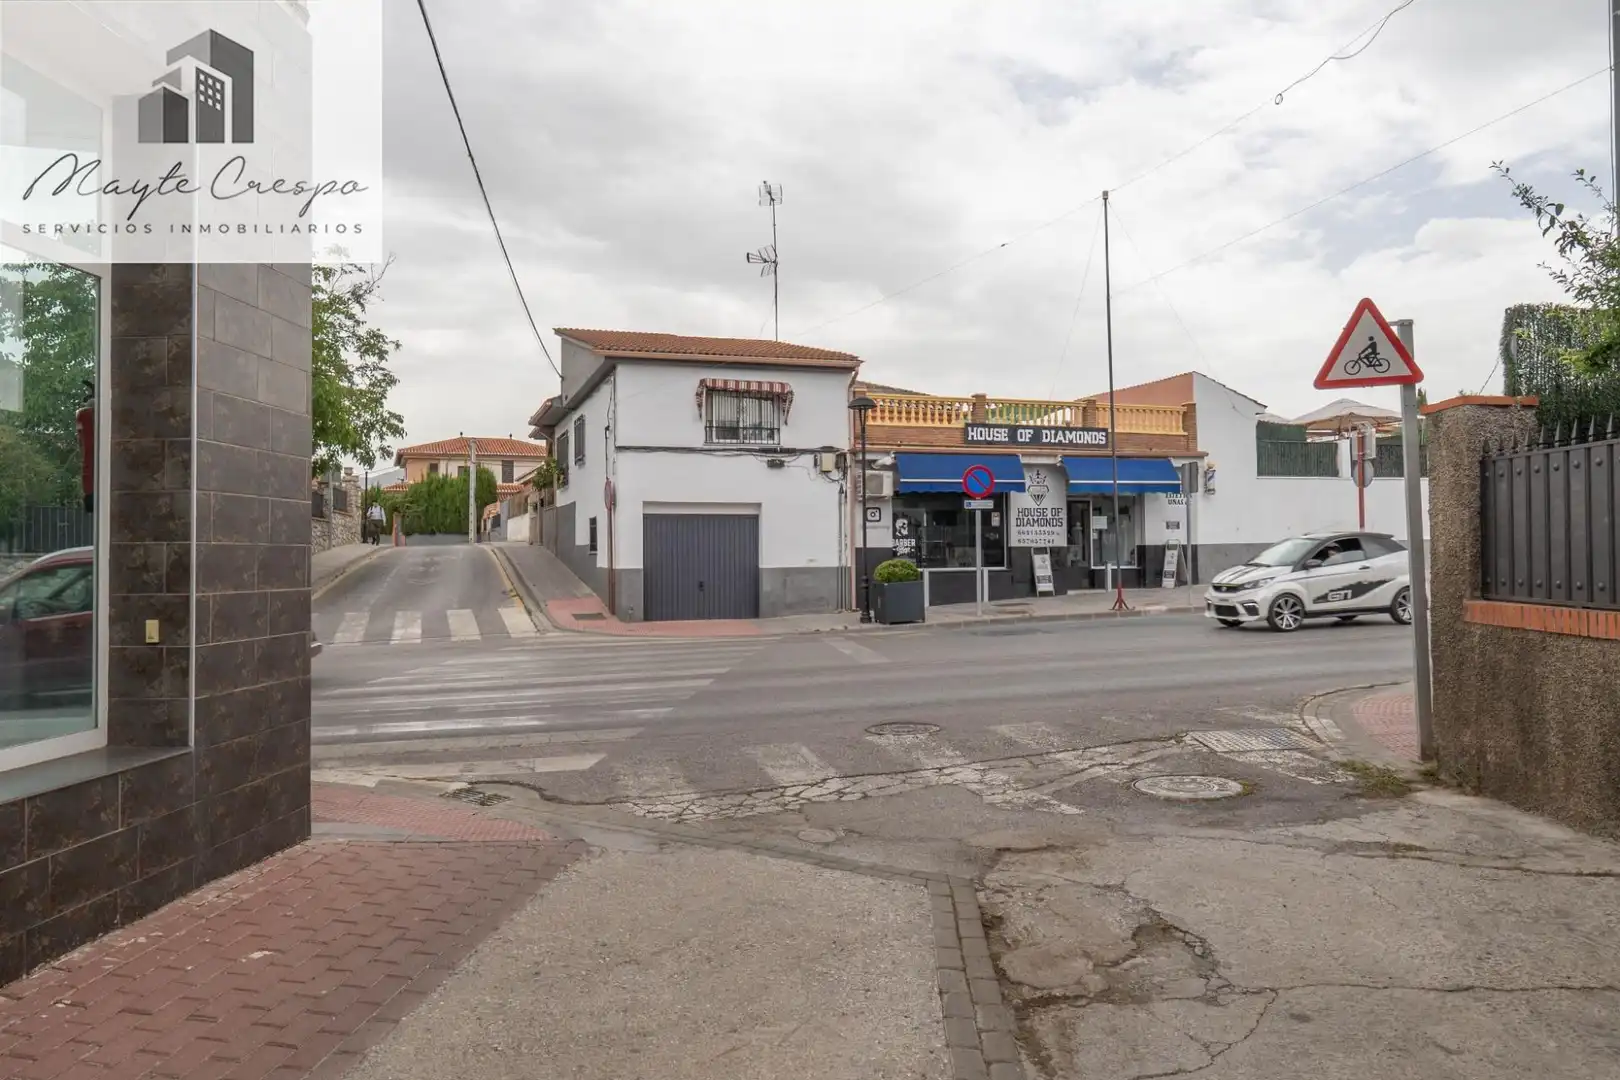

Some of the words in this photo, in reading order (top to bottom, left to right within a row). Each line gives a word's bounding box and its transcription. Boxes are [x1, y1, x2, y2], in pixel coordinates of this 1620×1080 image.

[967, 426, 1009, 441] HOUSE
[1017, 429, 1034, 442] OF
[1042, 429, 1107, 445] DIAMONDS
[1017, 507, 1048, 518] HOUSE
[1051, 507, 1063, 518] OF
[1015, 517, 1063, 528] DIAMONDS
